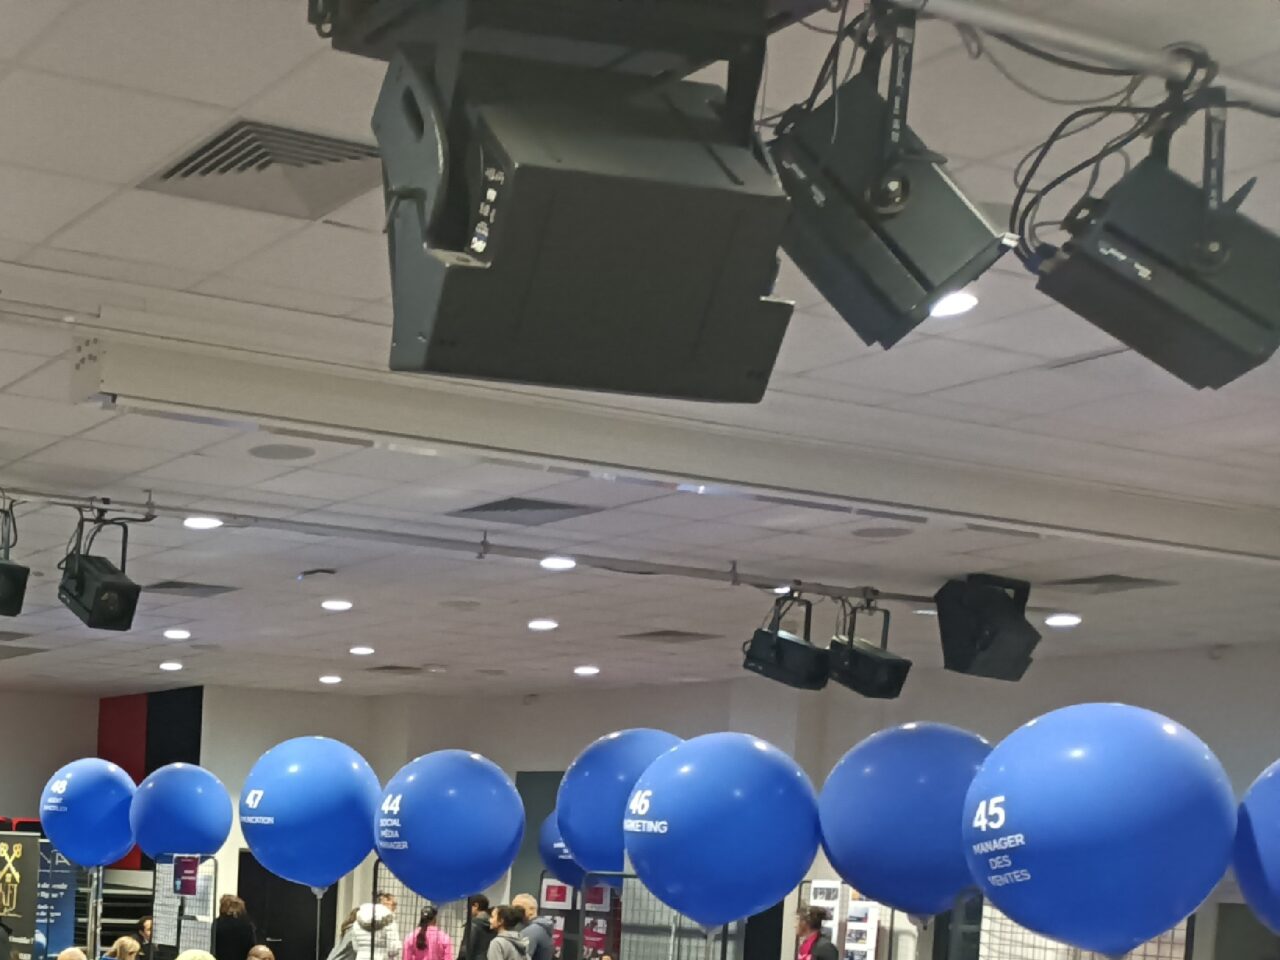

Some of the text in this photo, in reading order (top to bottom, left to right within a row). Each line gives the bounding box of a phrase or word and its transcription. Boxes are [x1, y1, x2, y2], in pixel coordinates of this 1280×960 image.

[245, 789, 264, 809] 47
[381, 794, 402, 815] 44
[629, 790, 652, 815] 46
[973, 795, 1006, 832] 45
[972, 833, 1026, 855] MANAGER
[988, 855, 1012, 871] DES
[987, 869, 1032, 887] VENTES
